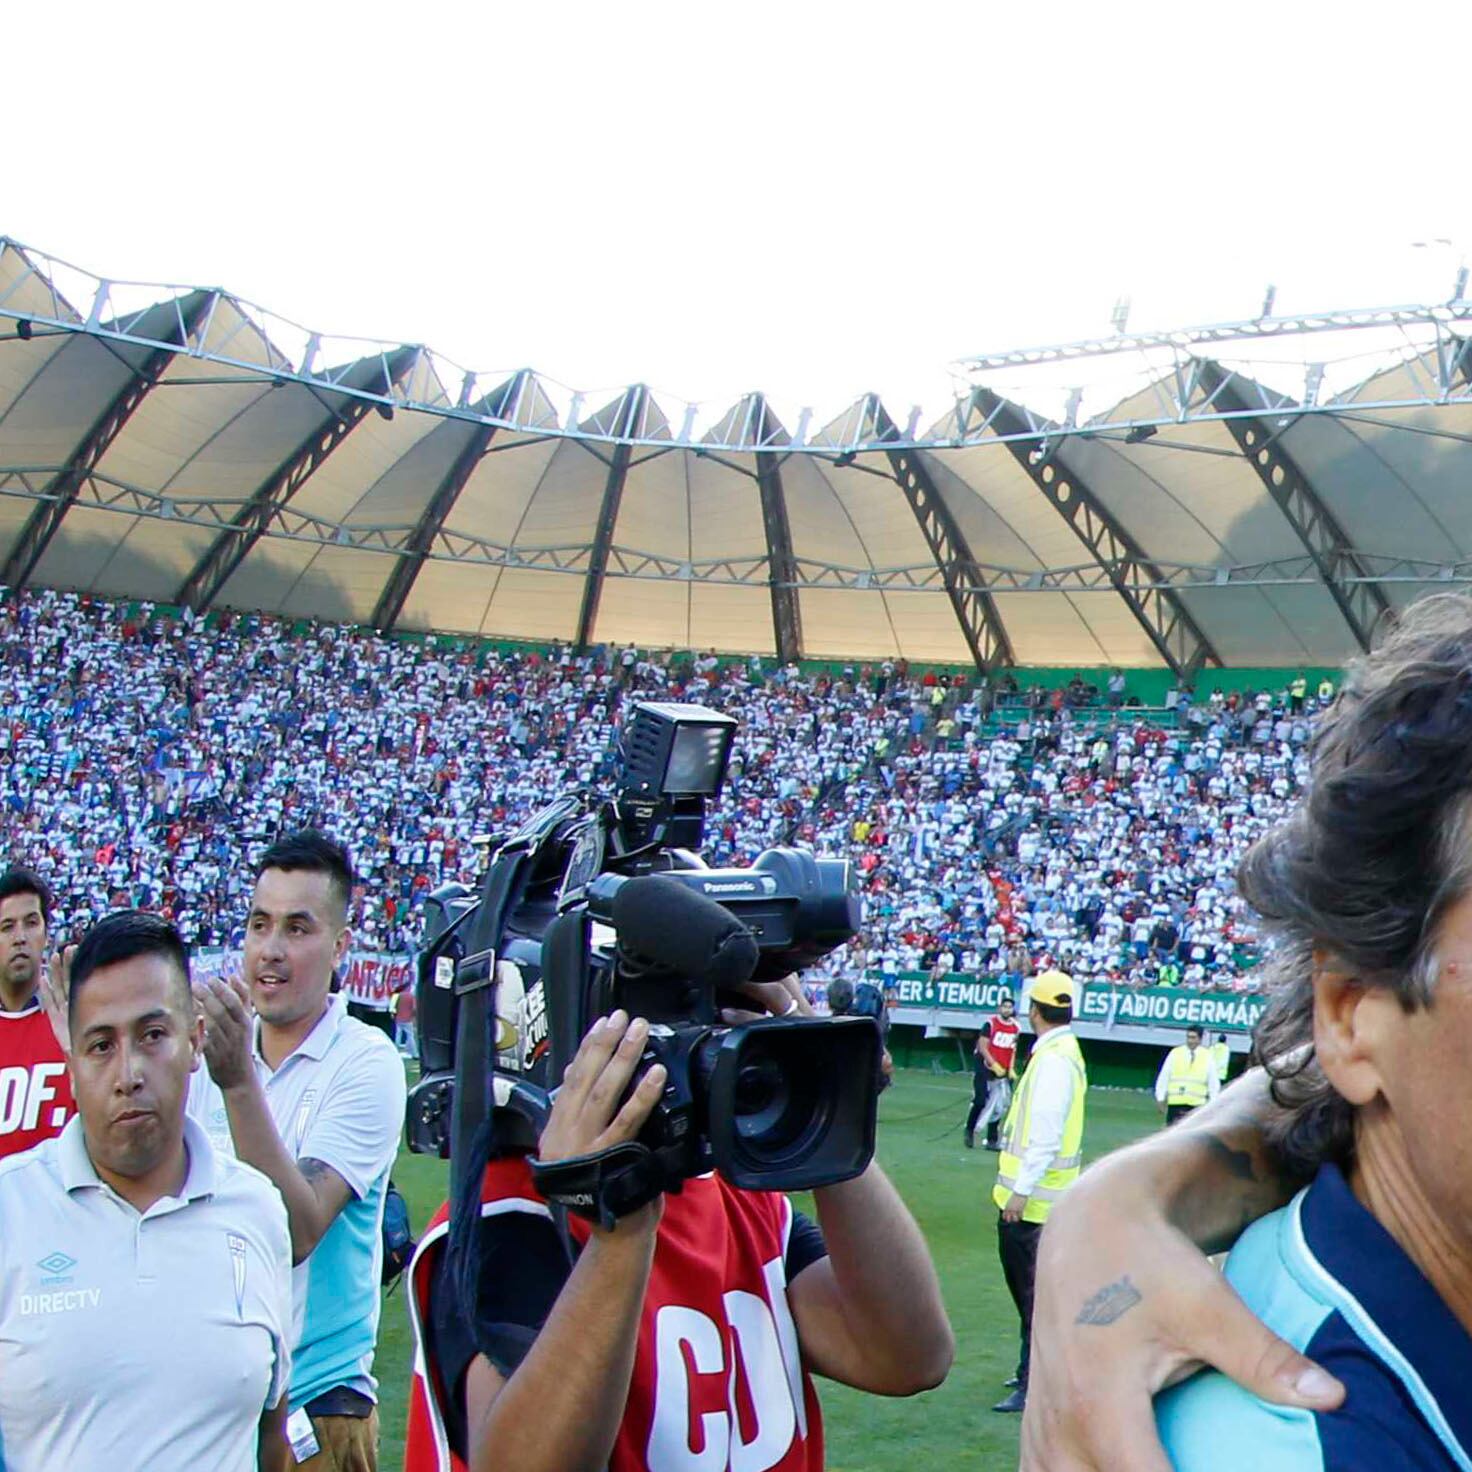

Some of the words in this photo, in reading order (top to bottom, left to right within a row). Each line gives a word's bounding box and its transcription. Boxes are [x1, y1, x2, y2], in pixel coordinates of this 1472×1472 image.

[703, 881, 756, 893] Panasonic
[937, 980, 1010, 1007] TEMUCO
[1083, 991, 1169, 1019] ESTADIO
[19, 1288, 101, 1316] DIRECTV
